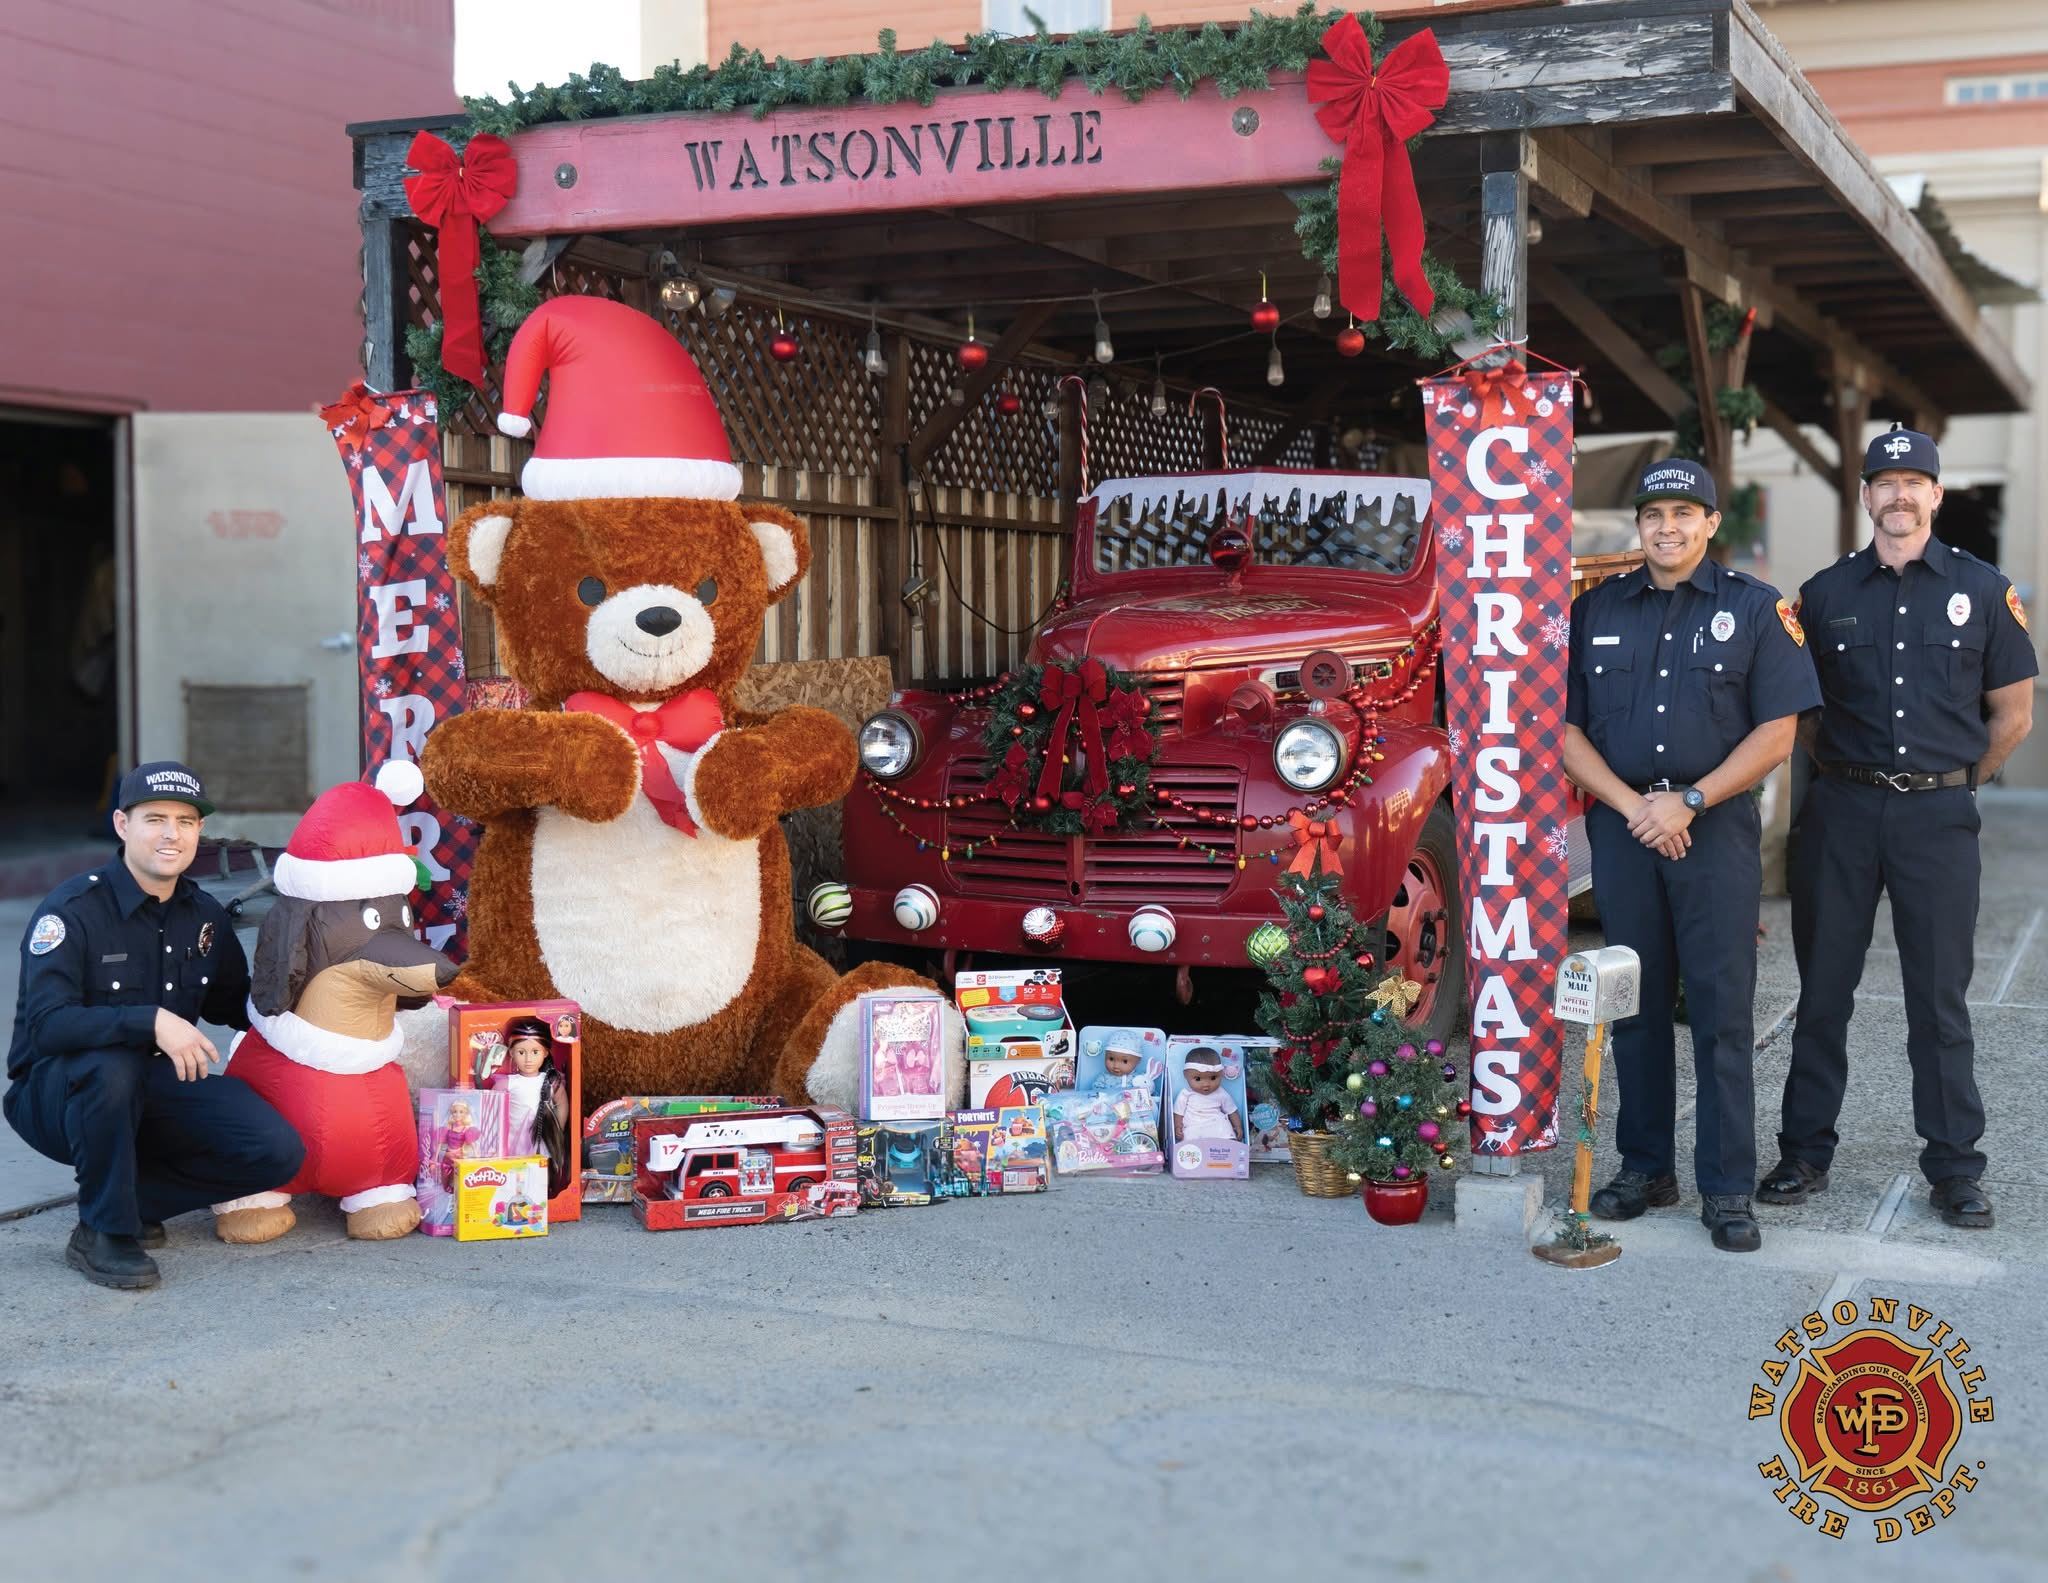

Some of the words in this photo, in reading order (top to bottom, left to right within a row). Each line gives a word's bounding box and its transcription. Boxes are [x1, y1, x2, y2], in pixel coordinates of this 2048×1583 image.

[684, 110, 1102, 192] WATSONVILLE
[1643, 468, 1696, 486] WATSONVILLE
[1647, 482, 1665, 491] FIRE
[1666, 482, 1690, 490] DEPT.
[1465, 426, 1539, 1115] CHRISTMAS
[146, 770, 200, 793] WATSONVILLE
[152, 784, 176, 792] FIRE
[1563, 970, 1592, 983] SANTA
[1567, 981, 1590, 993] MAIL
[1563, 998, 1590, 1007] SPECIAL
[1560, 1005, 1590, 1016] DELIVERY
[957, 1111, 995, 1123] FORTNITE
[611, 1120, 630, 1132] 16
[662, 1144, 679, 1155] 17
[1078, 1150, 1108, 1164] Barbie
[466, 1168, 507, 1187] Play-Doh
[698, 1208, 716, 1216] MEGA
[716, 1207, 731, 1215] FIRE
